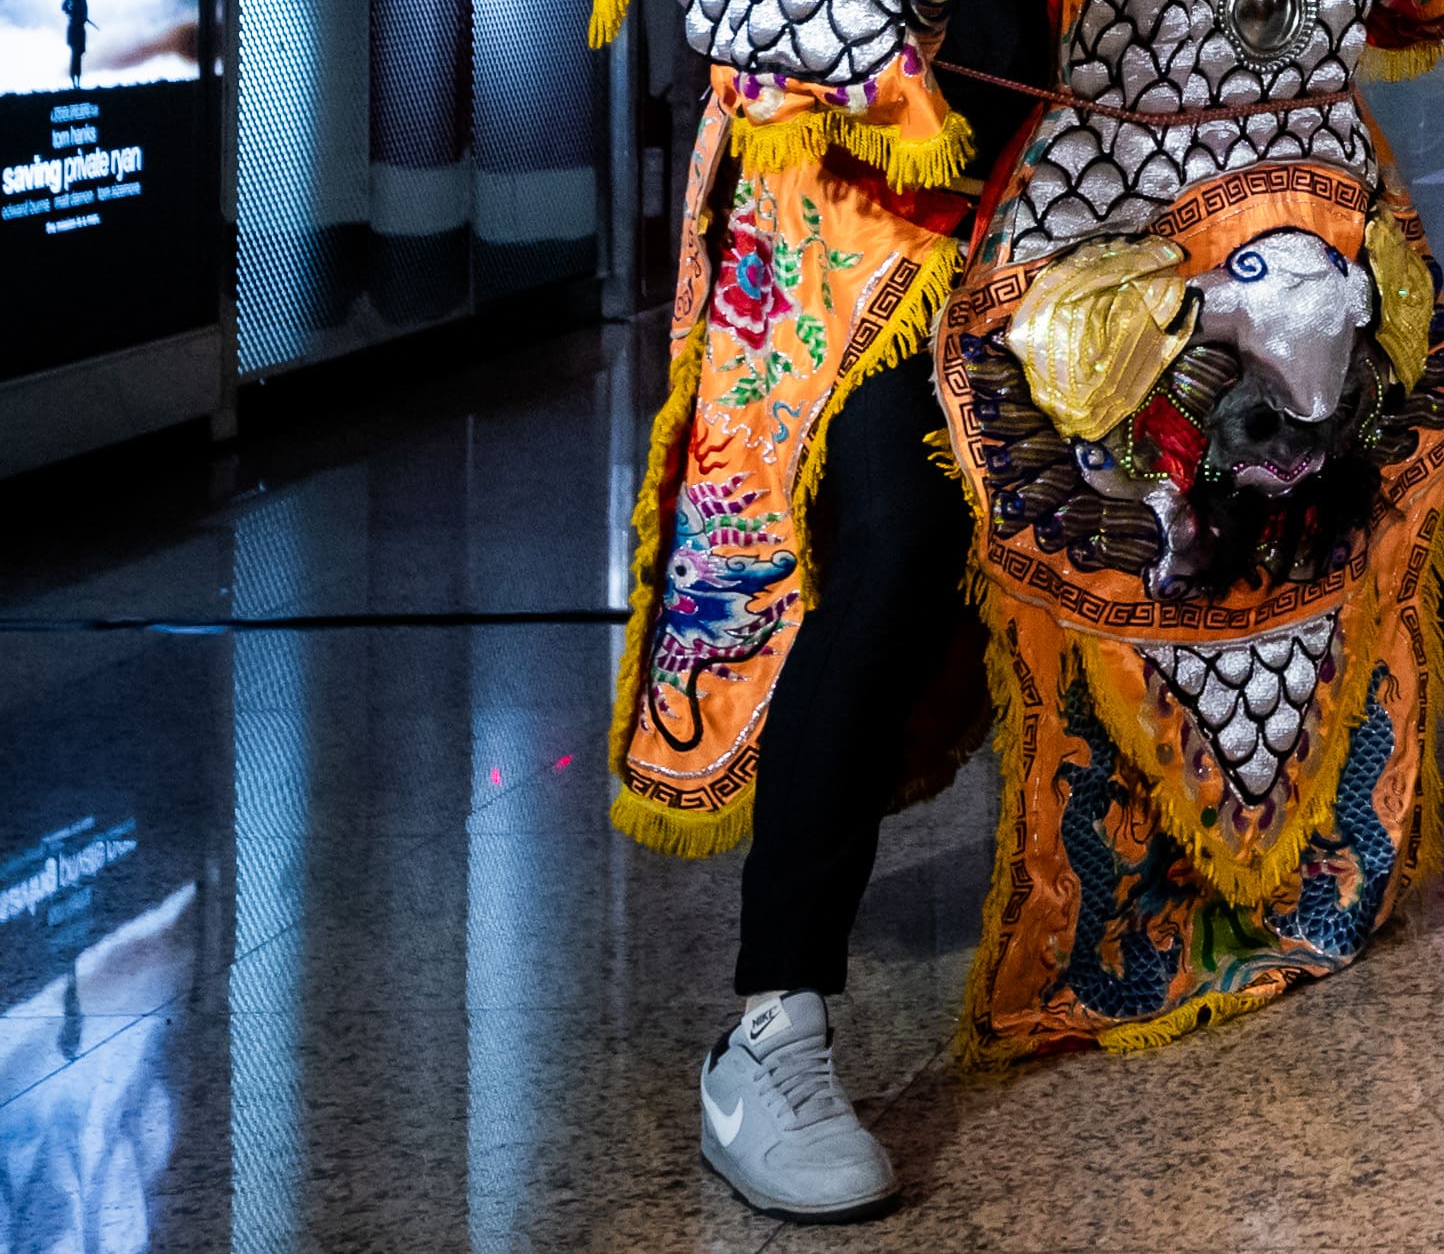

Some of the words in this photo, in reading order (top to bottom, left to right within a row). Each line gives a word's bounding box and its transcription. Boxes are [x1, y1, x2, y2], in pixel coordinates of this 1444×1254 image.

[2, 154, 62, 195] saving
[64, 147, 109, 191] private
[110, 146, 142, 182] ryan
[752, 1009, 776, 1028] NIKE
